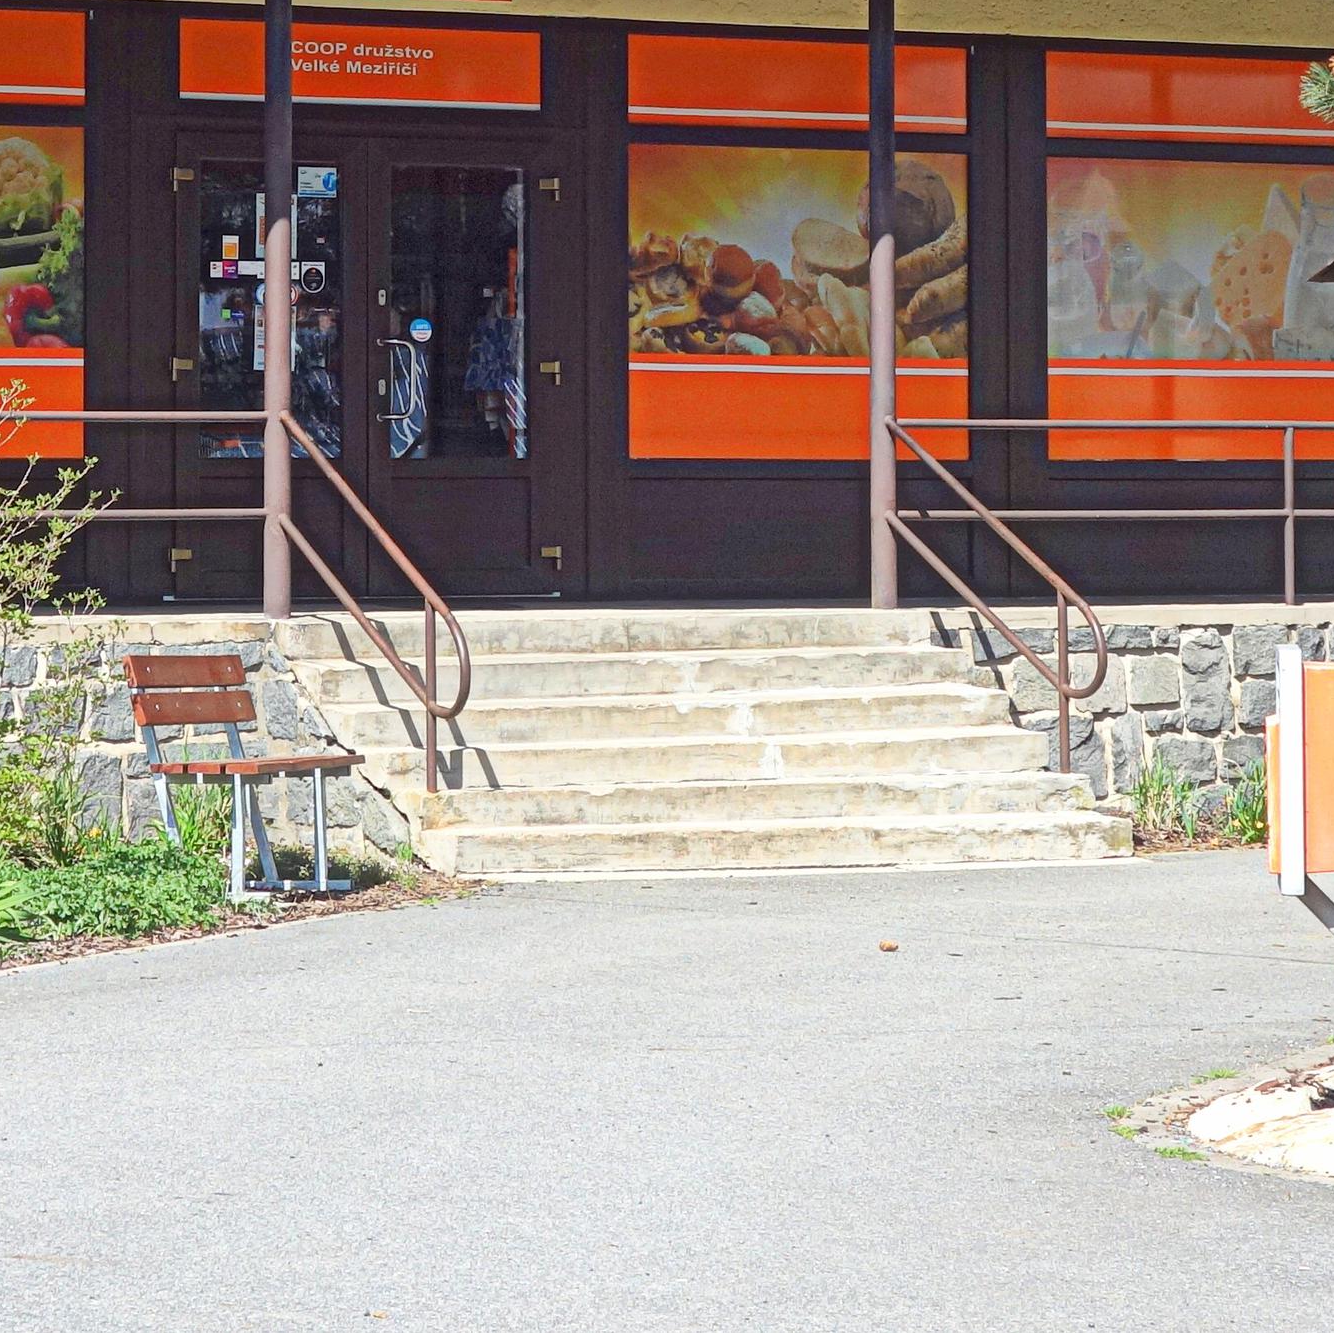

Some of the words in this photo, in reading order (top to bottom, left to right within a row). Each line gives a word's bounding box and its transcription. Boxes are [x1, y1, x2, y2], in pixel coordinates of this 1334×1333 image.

[291, 41, 347, 55] COOP
[353, 44, 434, 59] družstvo
[291, 58, 340, 73] Velké
[346, 61, 417, 76] Meziříčí
